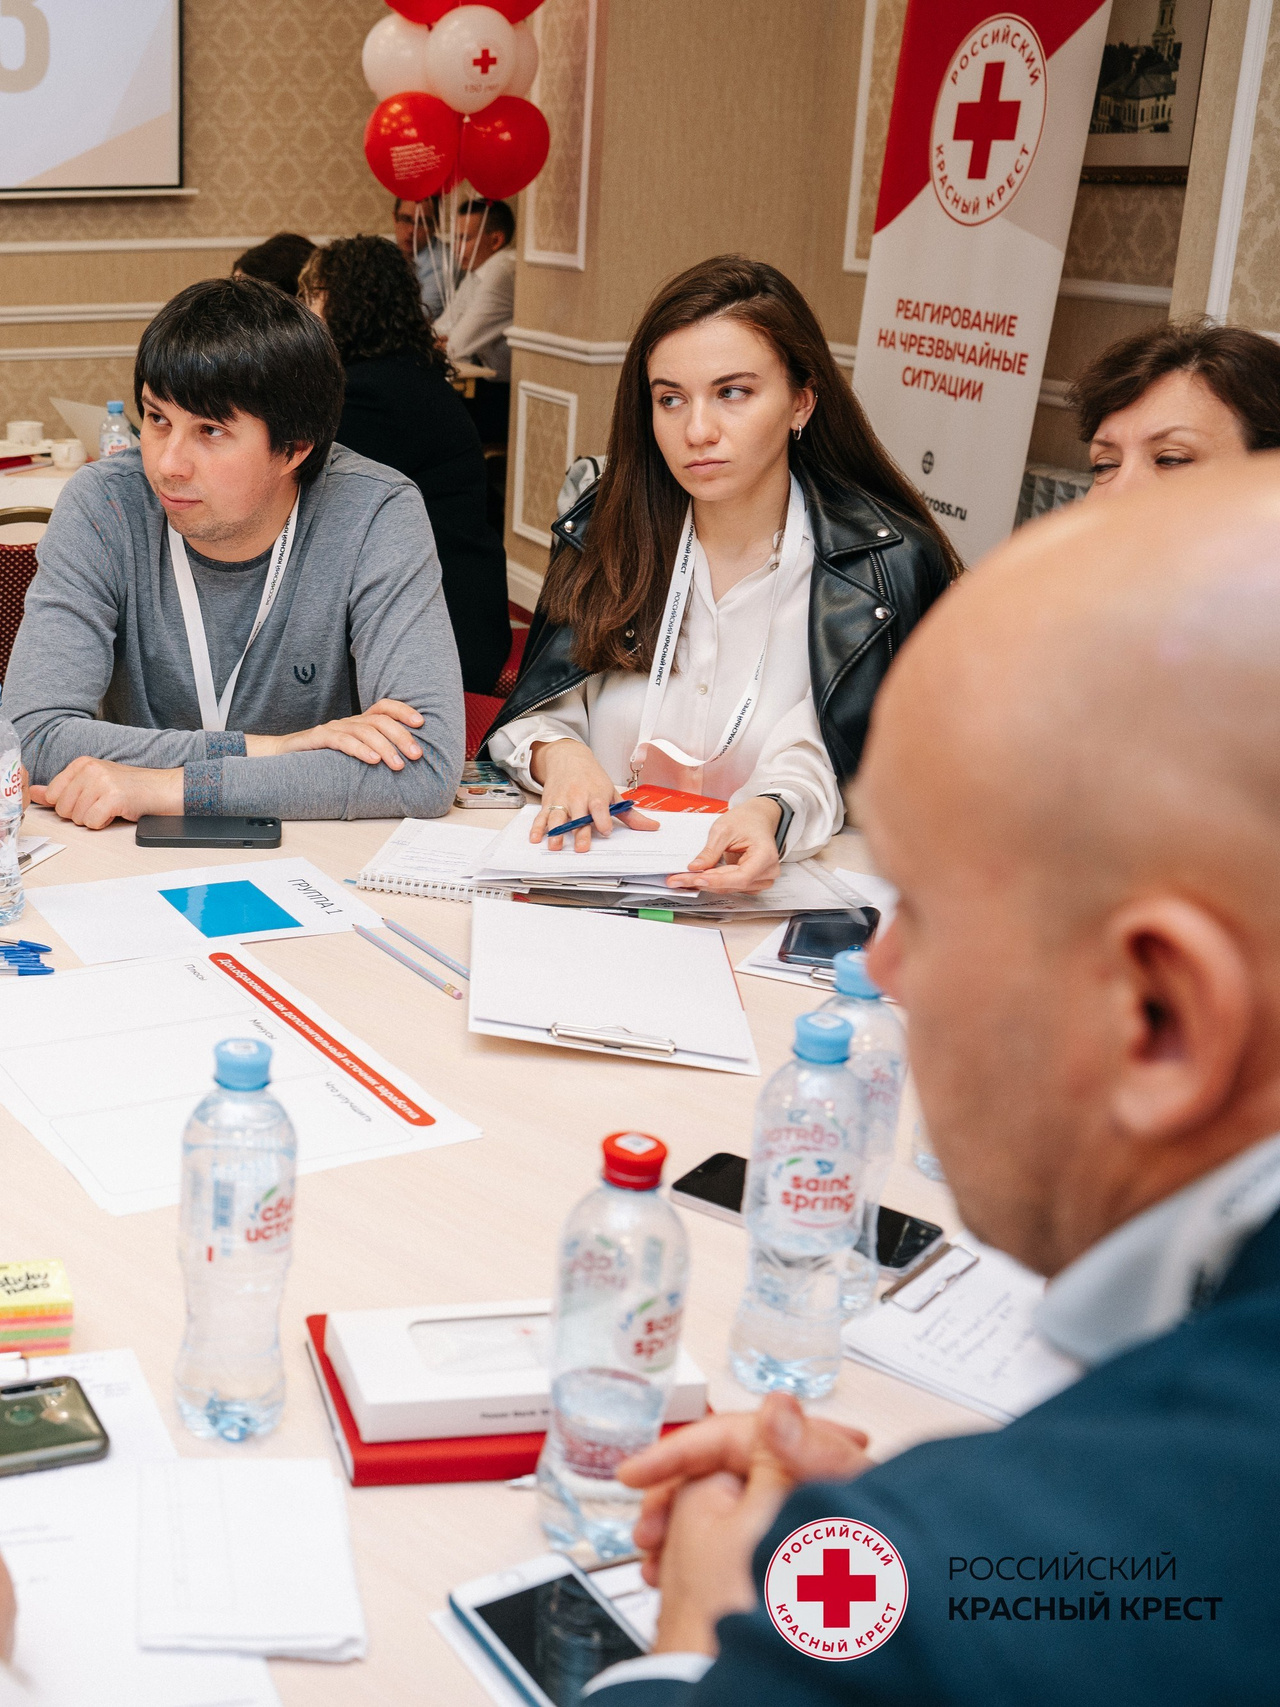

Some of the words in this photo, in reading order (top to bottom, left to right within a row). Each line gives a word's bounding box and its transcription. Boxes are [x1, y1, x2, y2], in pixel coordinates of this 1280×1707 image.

[951, 24, 1041, 86] РОССИЙСКИЙ
[936, 143, 980, 215] КРАСНЫЙ
[987, 143, 1029, 210] КРЕСТ
[896, 298, 1018, 337] РЕАГИРОВАНИЕ
[877, 328, 896, 350] НА
[900, 332, 1029, 376] ЧРЕЗВЫЧАЙНЫЕ
[902, 366, 984, 402] СИТУАЦИИ
[920, 491, 967, 521] ross.ru
[278, 534, 288, 565] КРАСНЫЙ
[680, 553, 692, 575] КРЕСТ
[666, 591, 681, 635] РОССИЙСКИЙ
[660, 634, 671, 666] КРАСНЫЙ
[655, 665, 666, 686] КРЕСТ
[726, 715, 745, 746] КРАСНЫЙ
[740, 697, 753, 717] КРЕСТ
[287, 878, 335, 909] ГРУППА
[184, 963, 207, 982] Плюсы
[248, 1018, 278, 1040] Минусы
[271, 1000, 288, 1012] как
[281, 1011, 347, 1059] дополнительный
[340, 1057, 380, 1086] источник
[374, 1084, 421, 1120] заработка
[325, 1081, 339, 1094] Что
[332, 1092, 372, 1122] улучшить
[791, 1174, 851, 1192] saint
[781, 1190, 856, 1214] spring
